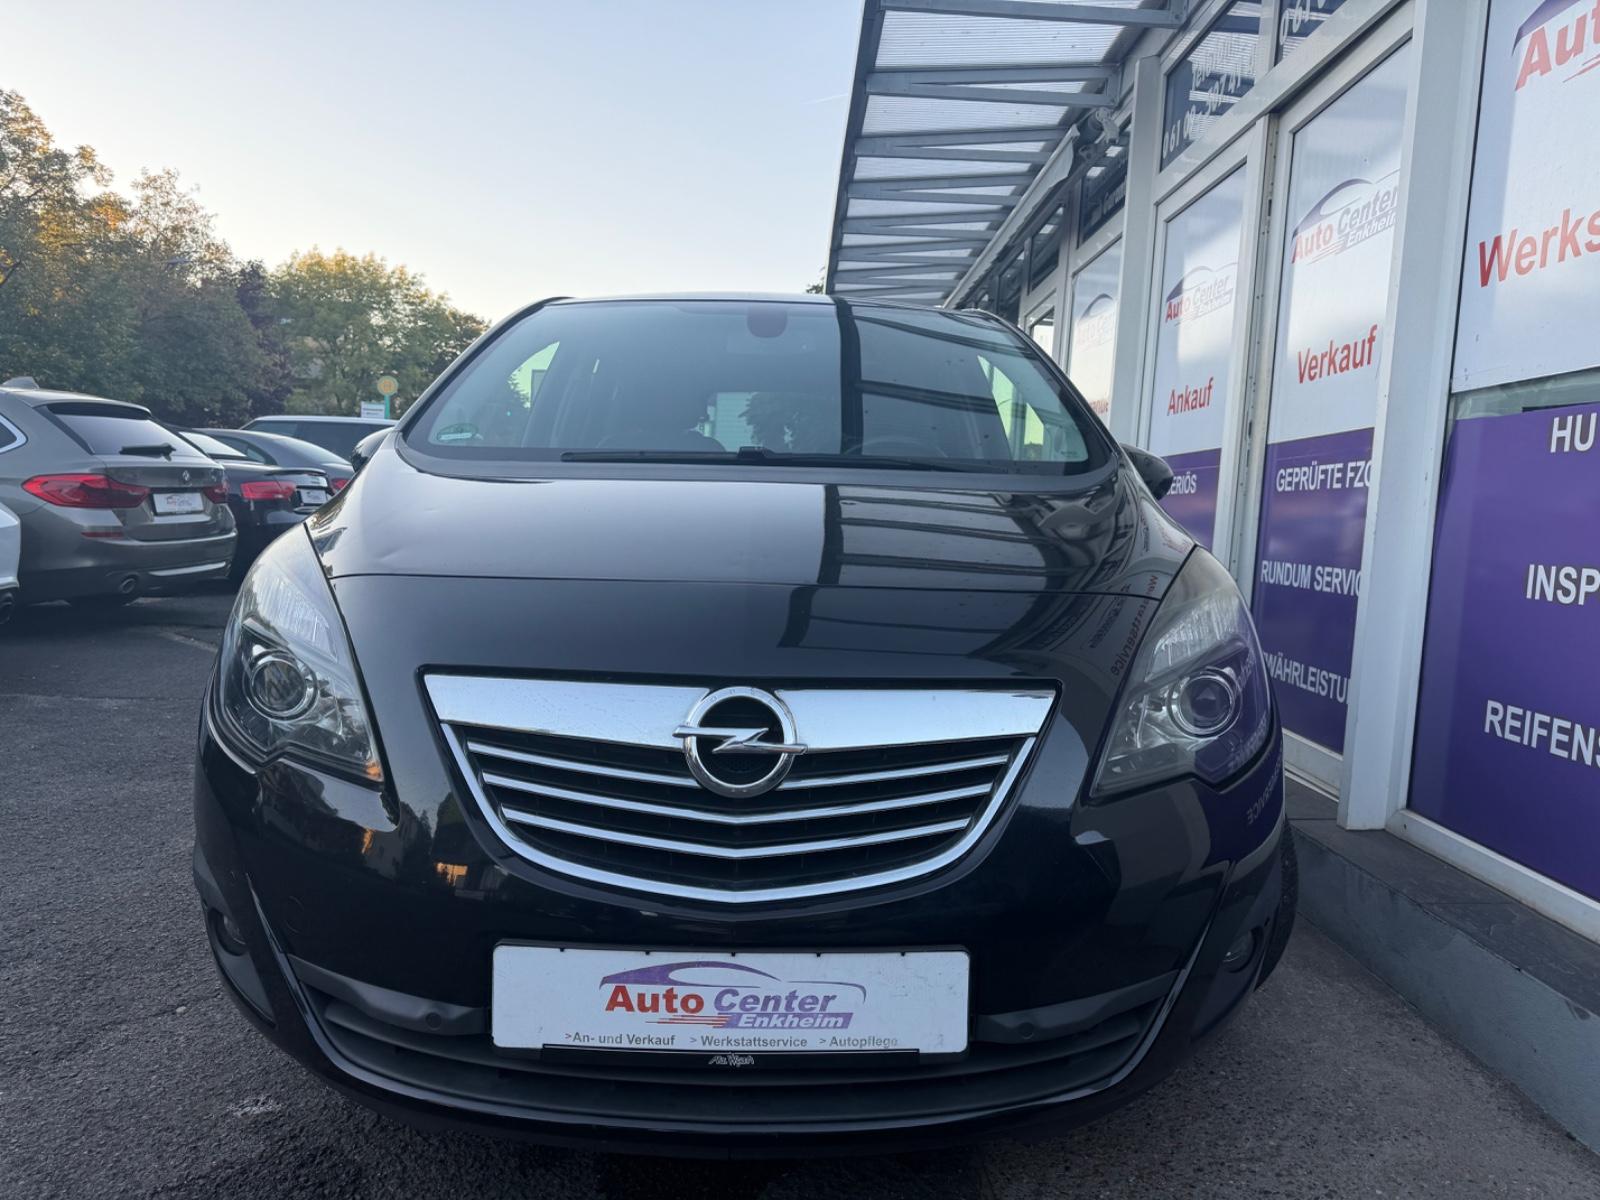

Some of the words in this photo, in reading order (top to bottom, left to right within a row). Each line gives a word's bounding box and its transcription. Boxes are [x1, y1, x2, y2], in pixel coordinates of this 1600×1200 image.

[1290, 222, 1334, 265] Auto
[1298, 323, 1377, 384] Verkauf
[1167, 377, 1214, 416] Ankauf
[1550, 412, 1598, 453] HU
[1166, 470, 1198, 496] ERIÖS
[1276, 460, 1342, 492] GEPRÜFTE
[1260, 560, 1311, 590] RUNDUM
[1526, 564, 1600, 606] INSP
[605, 985, 704, 1014] Auto
[714, 988, 837, 1013] Center
[737, 1013, 844, 1029] Enkheim
[599, 1033, 623, 1045] und
[626, 1034, 676, 1047] Verkauf
[701, 1035, 808, 1048] Werkstattservice
